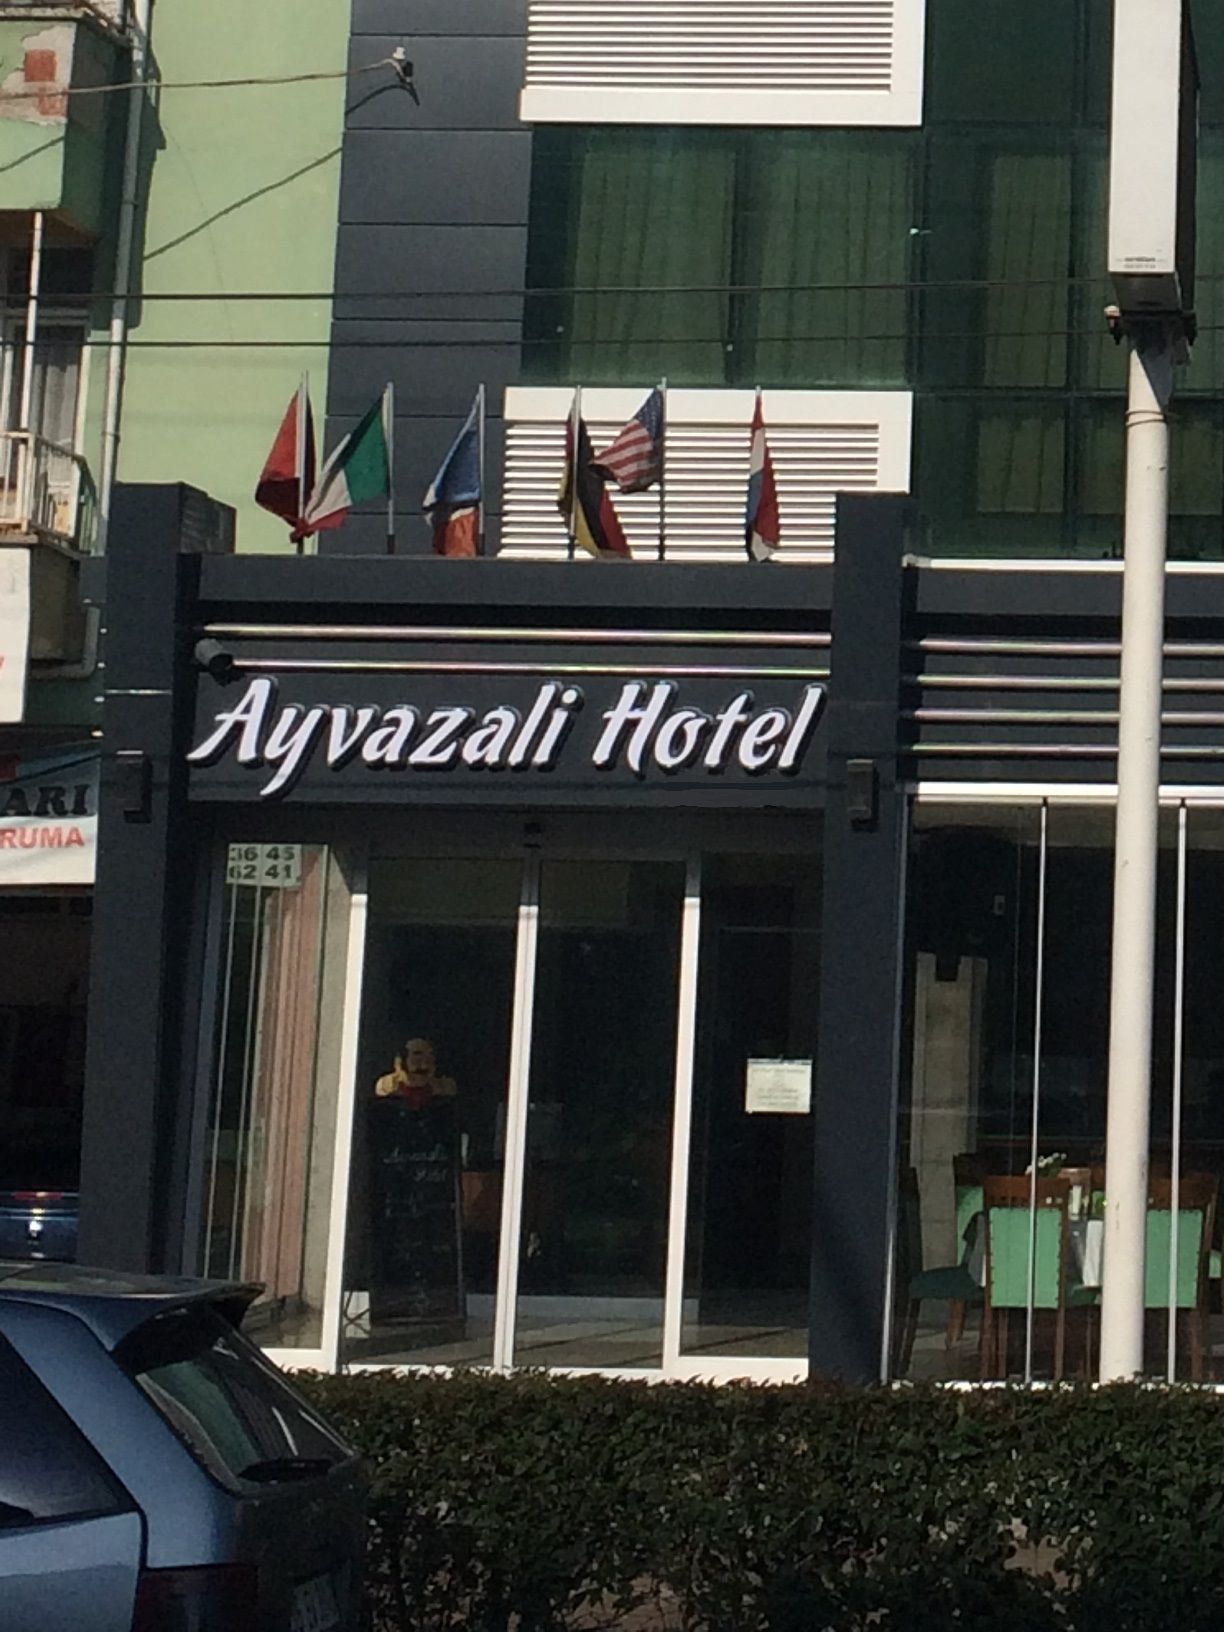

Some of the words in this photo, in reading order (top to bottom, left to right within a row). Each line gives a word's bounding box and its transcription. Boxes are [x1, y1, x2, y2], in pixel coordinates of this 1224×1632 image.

[187, 678, 583, 795] Ayvazali
[591, 680, 827, 774] Hotel
[266, 846, 295, 861] 45
